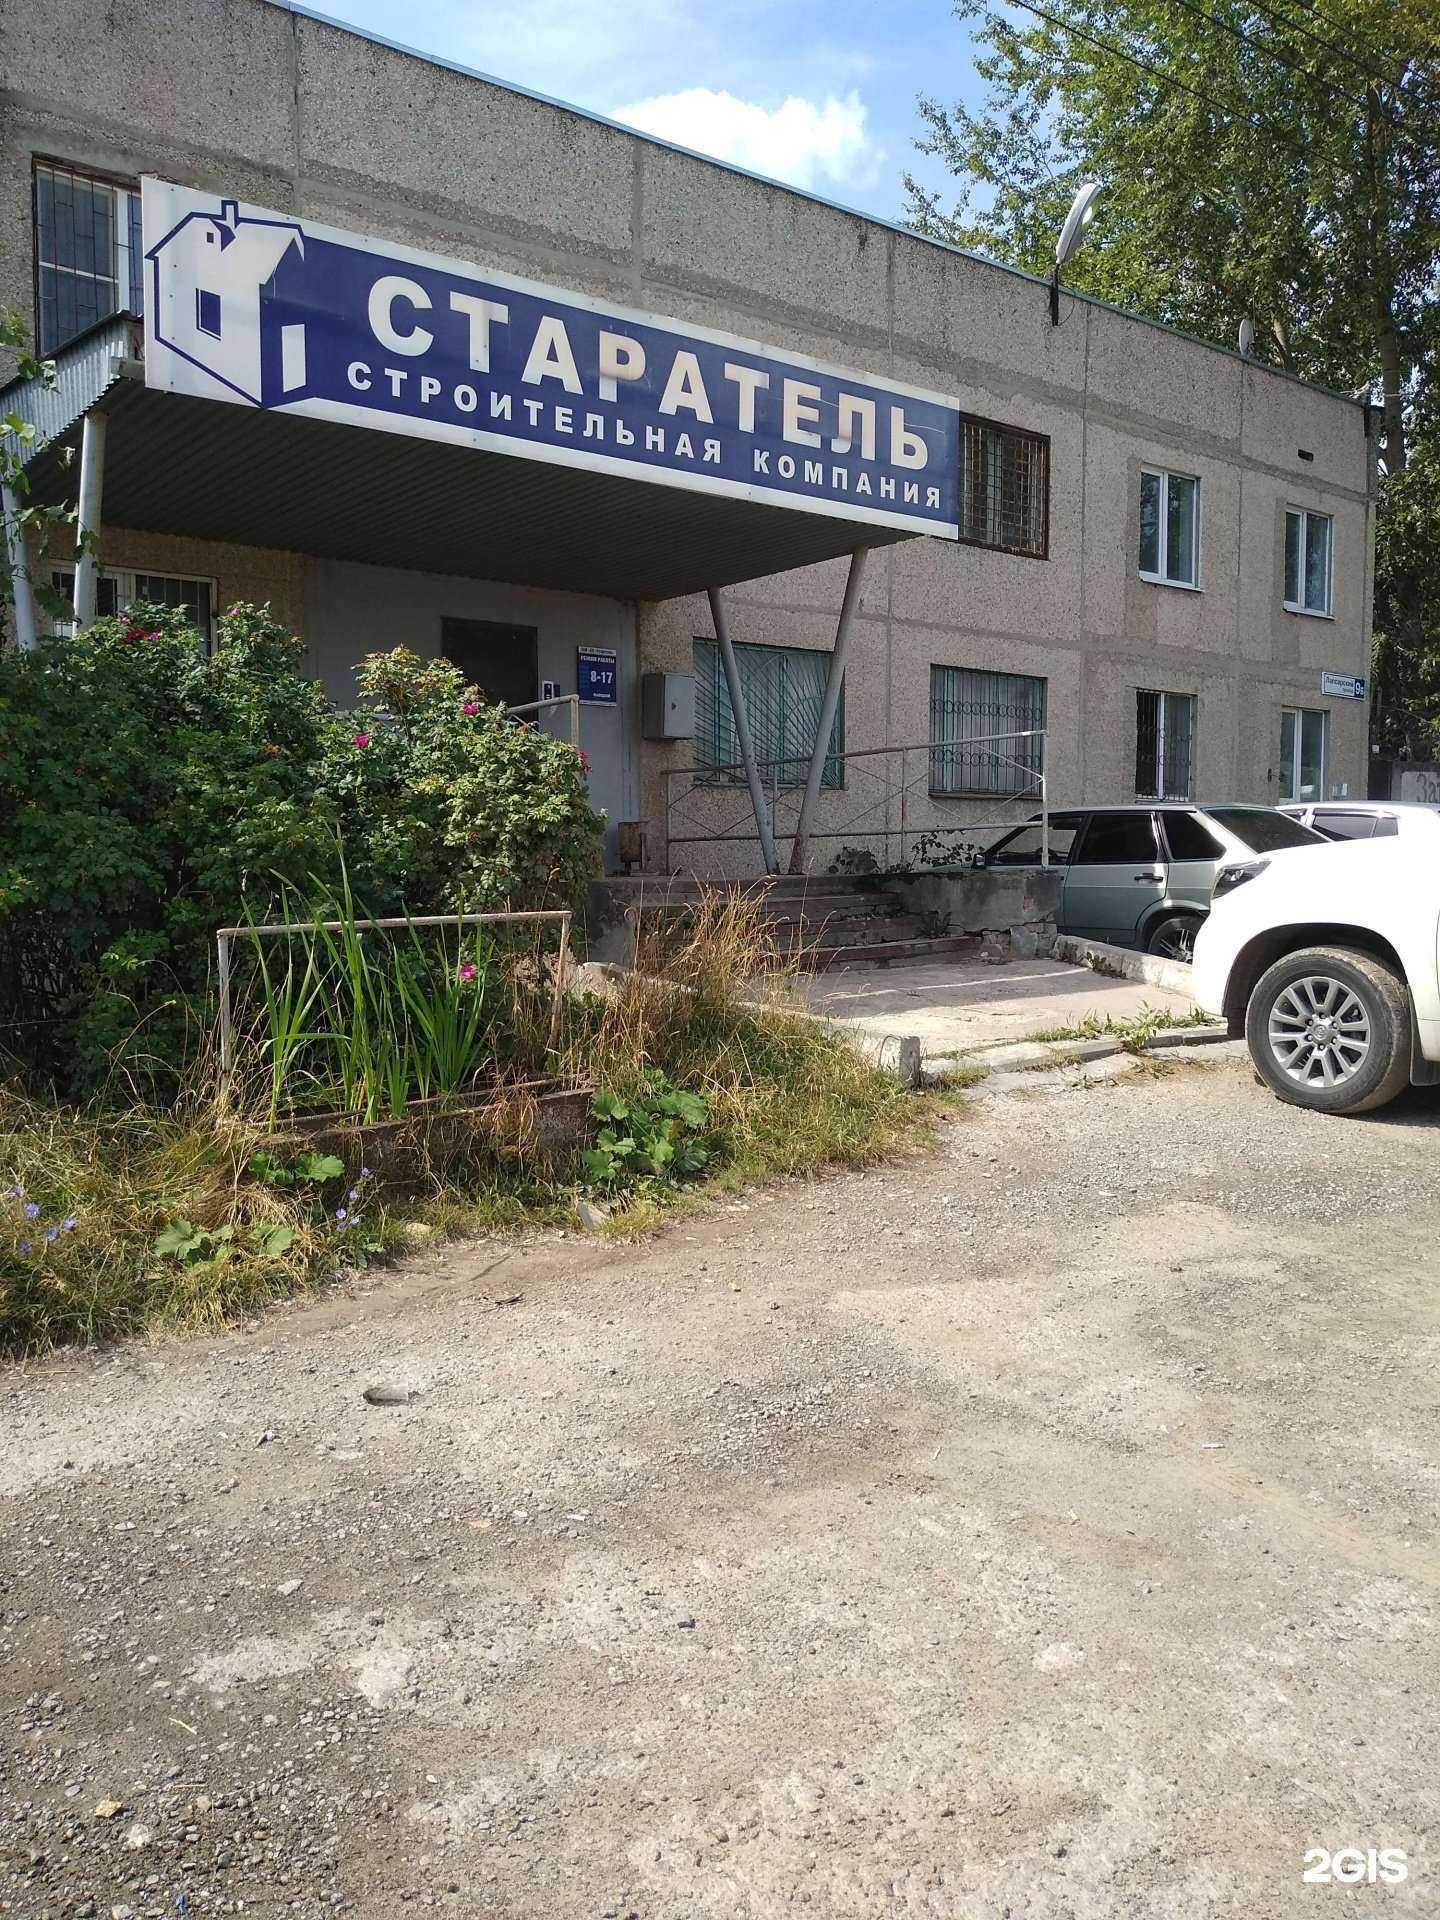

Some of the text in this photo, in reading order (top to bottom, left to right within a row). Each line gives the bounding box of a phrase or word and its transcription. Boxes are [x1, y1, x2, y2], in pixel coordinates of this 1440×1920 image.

[347, 361, 943, 511] СТРОИТЕЛЬНАЯ КОМПАНИЯ
[367, 275, 931, 470] СТАРАТЕЛЬ
[590, 671, 613, 684] 8-17
